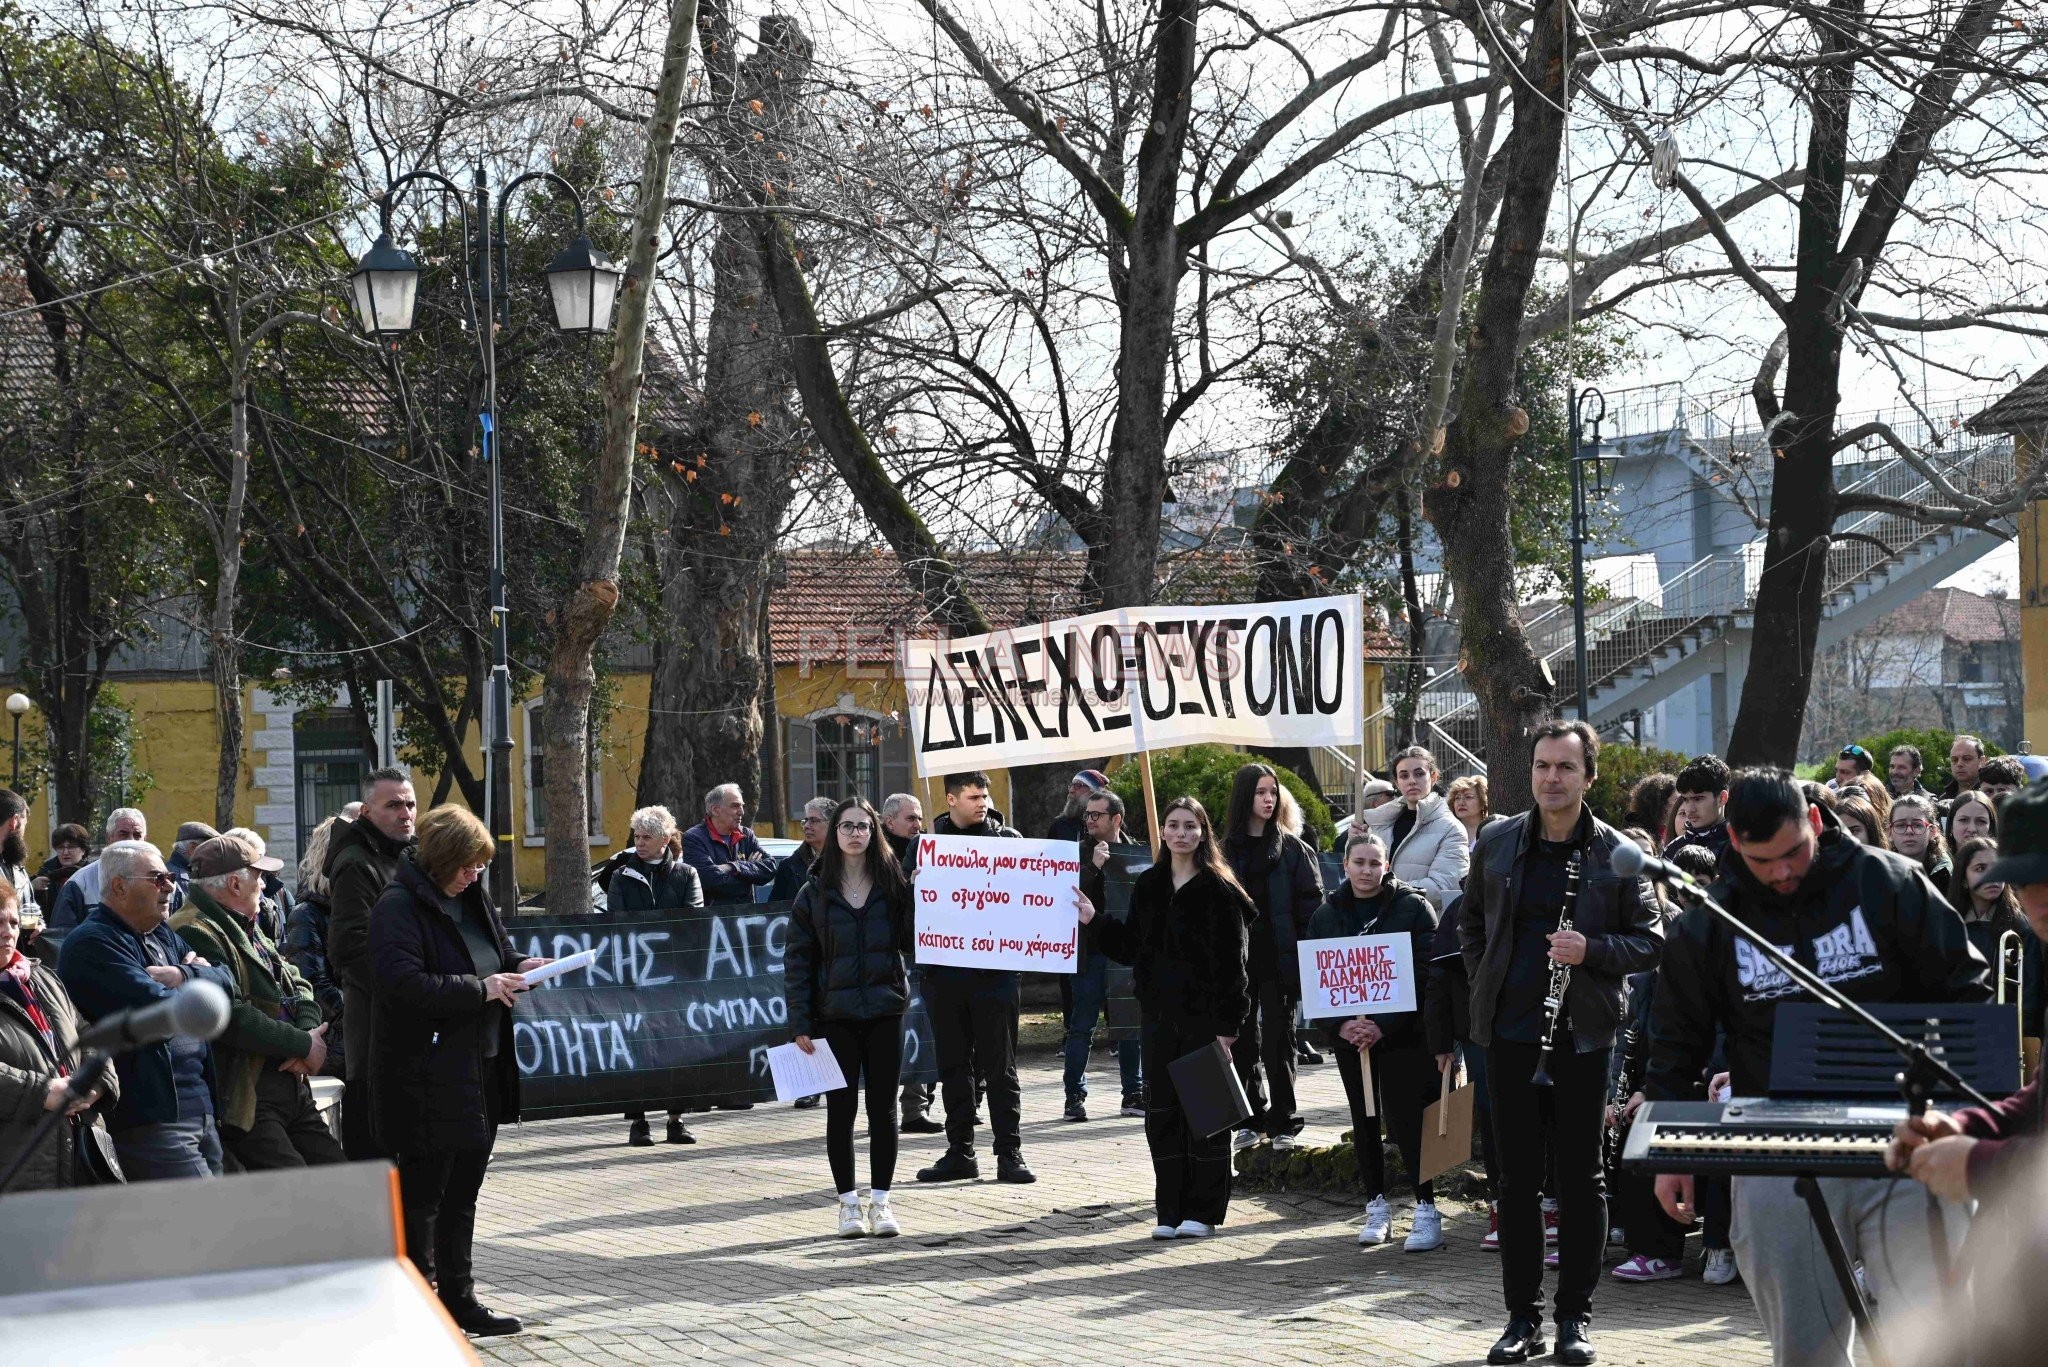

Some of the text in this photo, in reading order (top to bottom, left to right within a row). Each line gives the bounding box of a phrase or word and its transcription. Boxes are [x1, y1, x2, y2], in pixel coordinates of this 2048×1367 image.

[993, 856, 1016, 875] μου
[1019, 852, 1080, 876] στέρησαν
[920, 882, 1054, 910] το οξυγόνο που
[918, 926, 1076, 959] κάποτε εσύ μου χάρισες!
[1316, 945, 1391, 970] ΙΟΡΔΑΝΗΣ
[1320, 962, 1398, 988] ΑΔΑΜΑΚΗΣ
[1329, 981, 1391, 1006] ΕΤΩΝ 22
